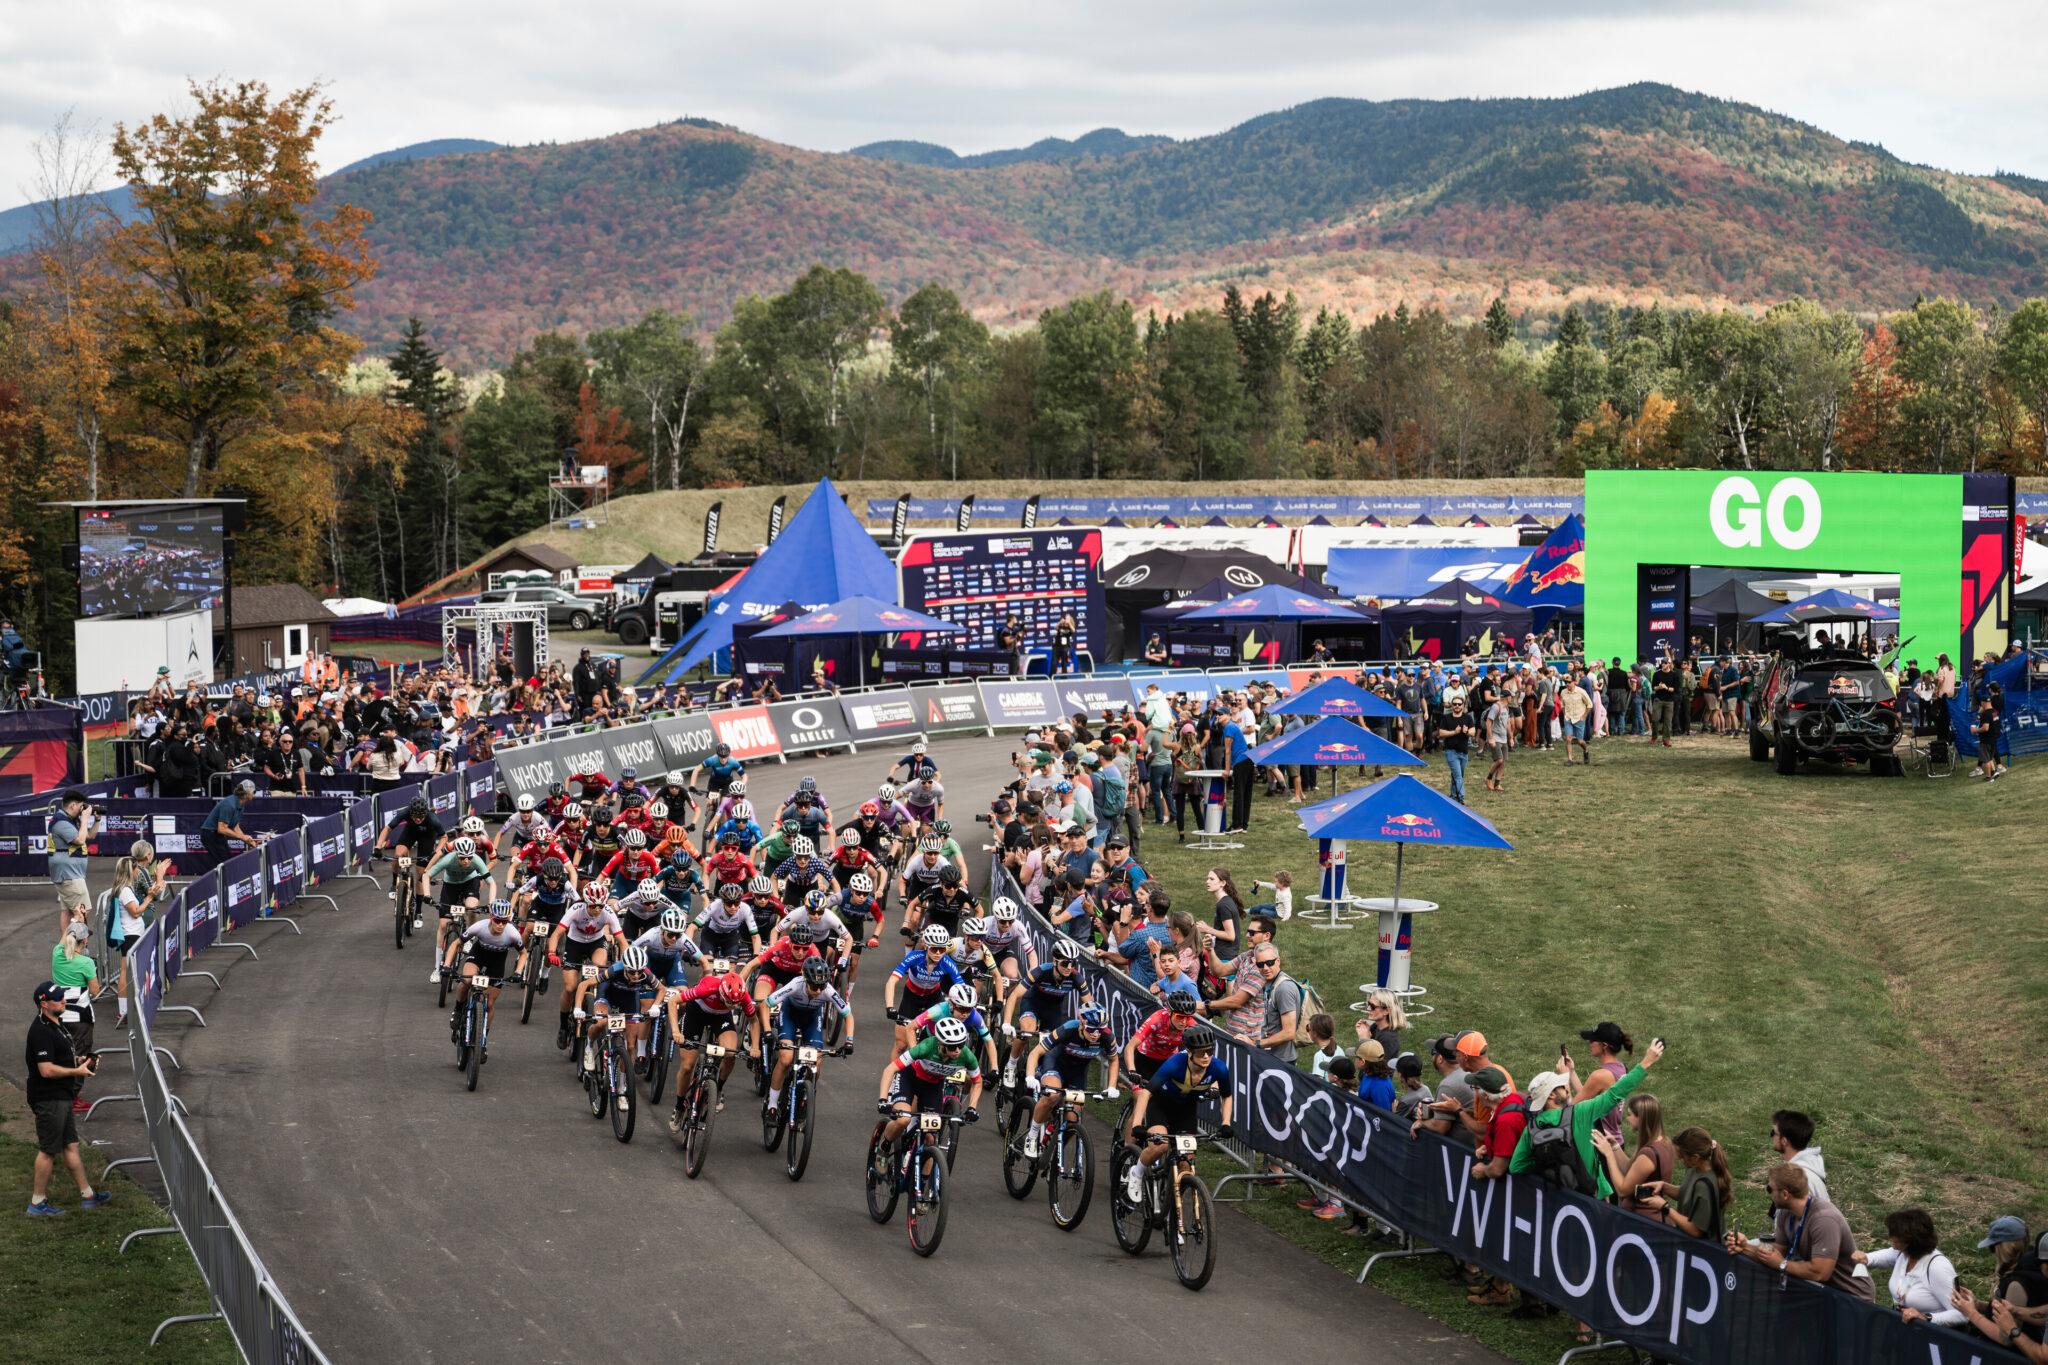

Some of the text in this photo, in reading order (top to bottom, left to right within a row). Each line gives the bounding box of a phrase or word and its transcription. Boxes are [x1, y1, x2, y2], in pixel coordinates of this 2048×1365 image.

[1710, 476, 1822, 550] GO
[2015, 524, 2023, 560] SWISS
[1548, 539, 1579, 558] Red
[1650, 567, 1675, 576] WHOOP
[1651, 620, 1675, 630] MOTUL
[718, 716, 777, 750] MOTUL
[790, 728, 835, 744] OAKLEY
[667, 729, 713, 756] WHOOP
[613, 740, 654, 767] WHOOP
[564, 750, 604, 776] WHOOP
[510, 761, 553, 791] WHOOP
[1381, 826, 1442, 838] Red Bull
[585, 967, 596, 975] 25
[475, 977, 486, 985] 11
[611, 1019, 623, 1027] 27
[713, 1046, 718, 1054] 1
[805, 1050, 811, 1059] 4
[929, 1062, 956, 1071] SANTA
[1072, 1093, 1079, 1101] 7
[924, 1118, 938, 1127] 16
[1183, 1139, 1190, 1148] 6
[1441, 1145, 1719, 1345] WHOOP
